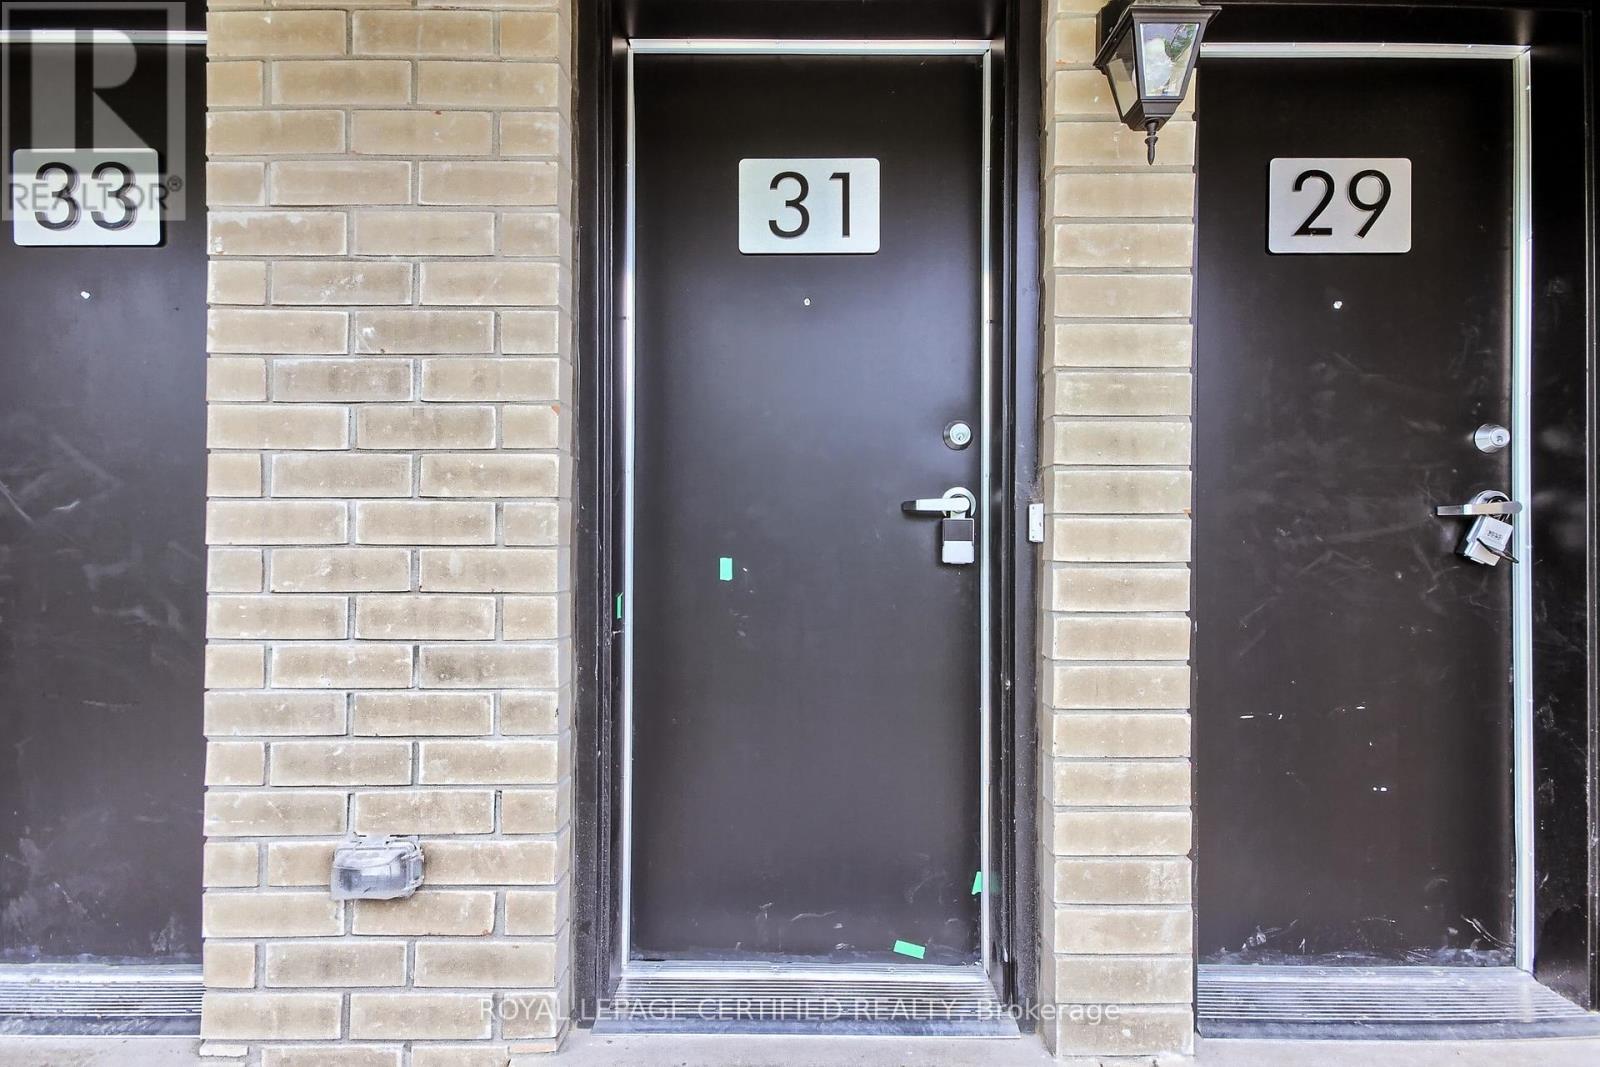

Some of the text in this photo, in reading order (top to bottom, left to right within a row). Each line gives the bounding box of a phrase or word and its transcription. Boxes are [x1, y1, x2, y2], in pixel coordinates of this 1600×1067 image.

[34, 161, 138, 231] 33
[768, 171, 850, 239] 31
[1292, 169, 1392, 238] 29
